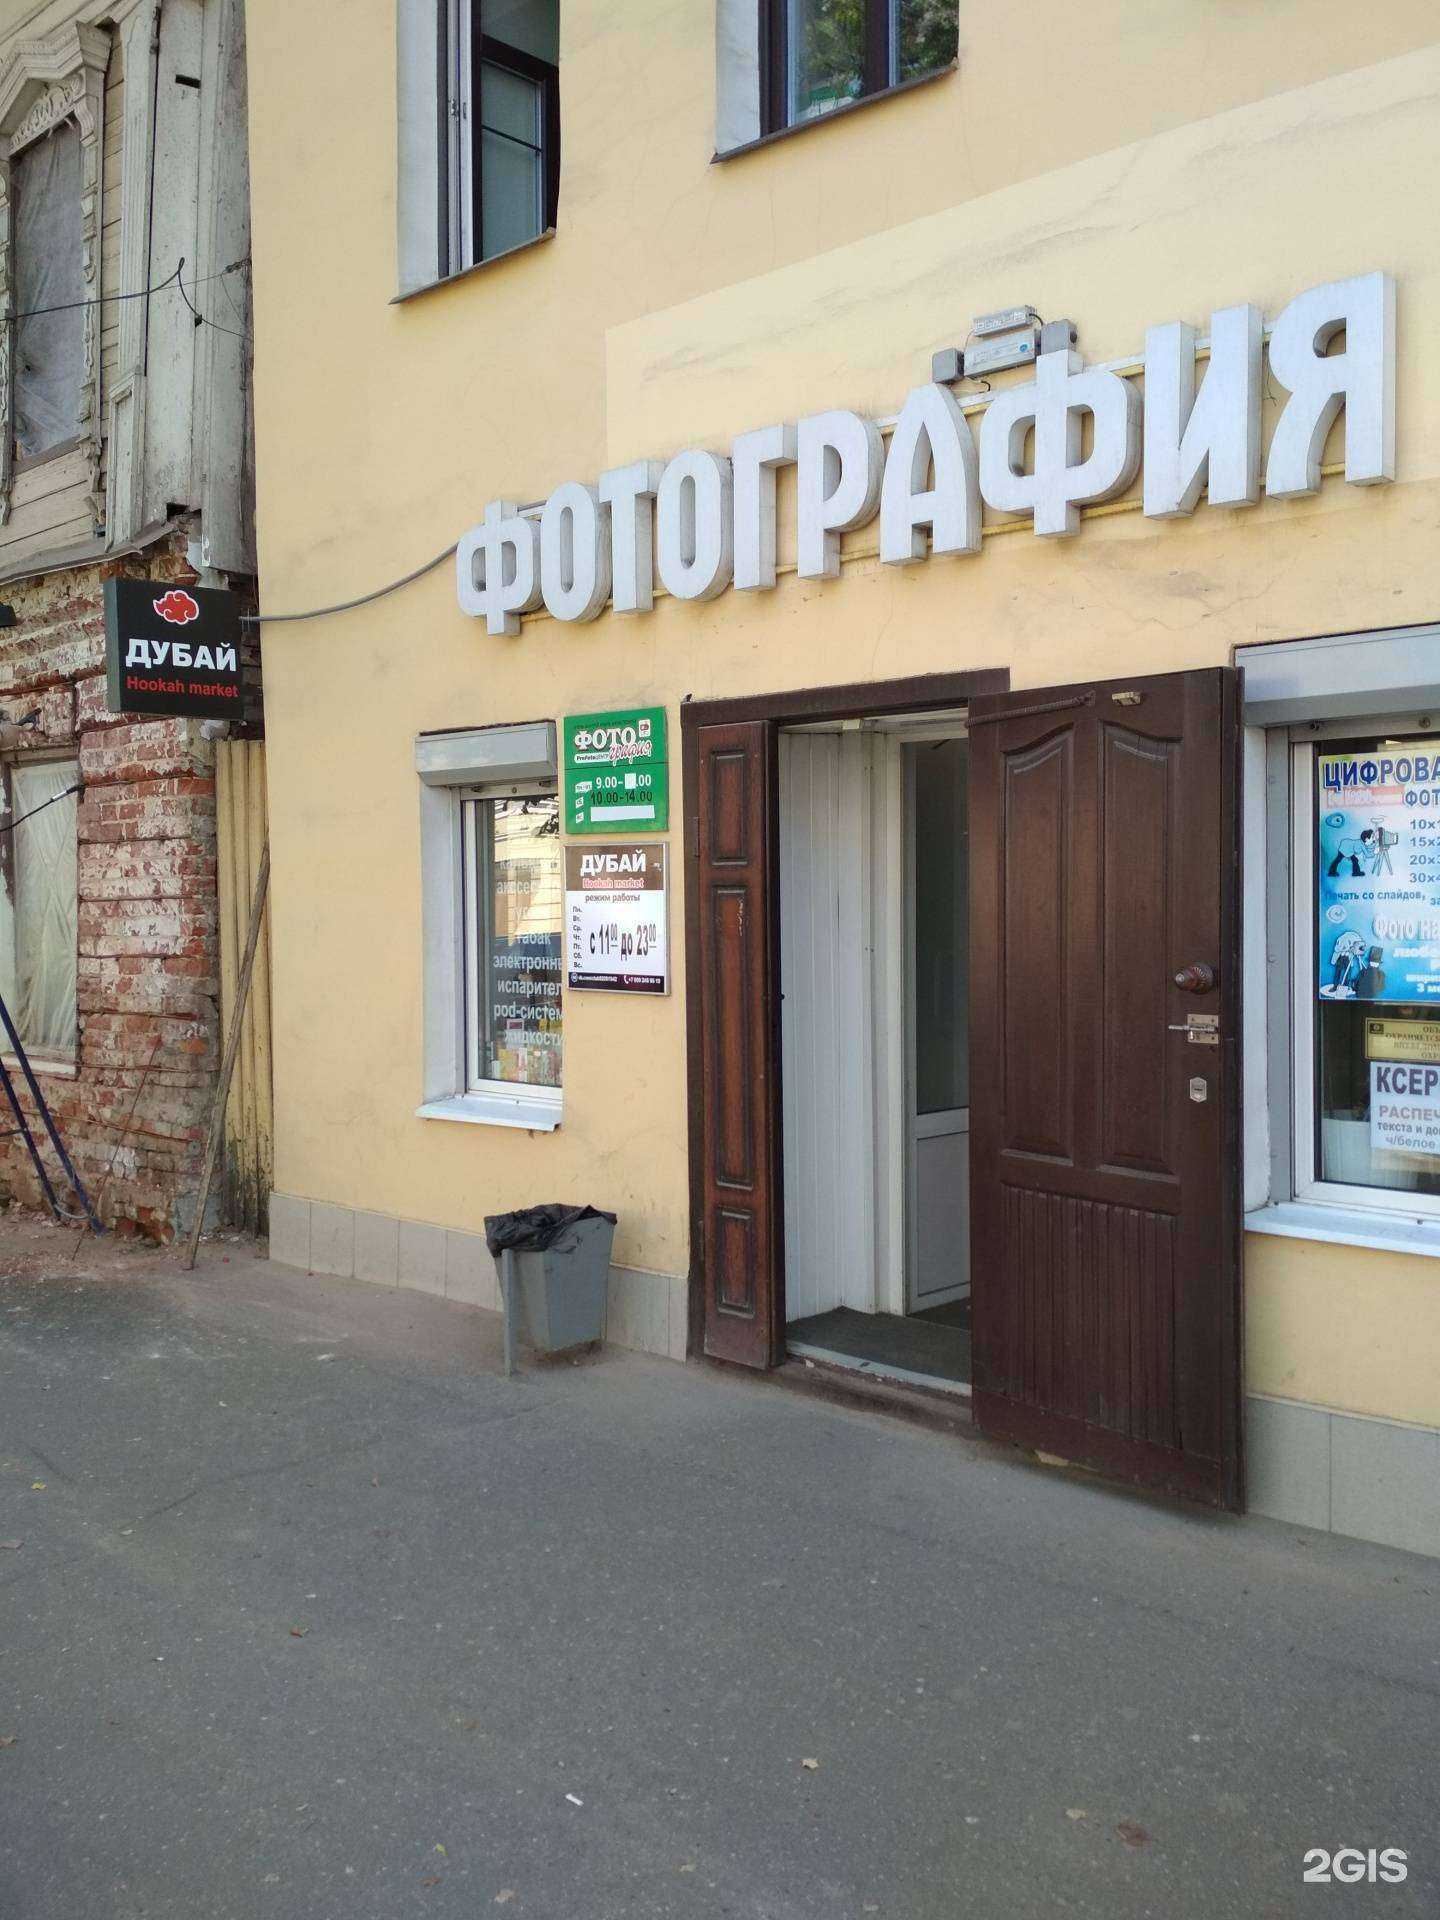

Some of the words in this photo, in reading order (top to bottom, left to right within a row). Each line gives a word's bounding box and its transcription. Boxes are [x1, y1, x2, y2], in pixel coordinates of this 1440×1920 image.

[456, 270, 1397, 637] ФОТОГРАФИЯ
[125, 638, 237, 672] ДУБАЙ
[126, 676, 185, 694] Hookah
[189, 682, 239, 698] market
[574, 727, 636, 751] ФОТО
[580, 849, 647, 876] ДУБАЙ
[582, 877, 613, 889] Hookah
[614, 877, 645, 889] market
[584, 895, 611, 904] режим
[612, 893, 641, 904] работы
[1362, 891, 1375, 900] со
[620, 932, 633, 961] до
[1376, 1066, 1439, 1096] КСЕР
[1377, 1122, 1413, 1132] текста
[1416, 1126, 1422, 1134] и
[1386, 1135, 1436, 1149] ч/белое
